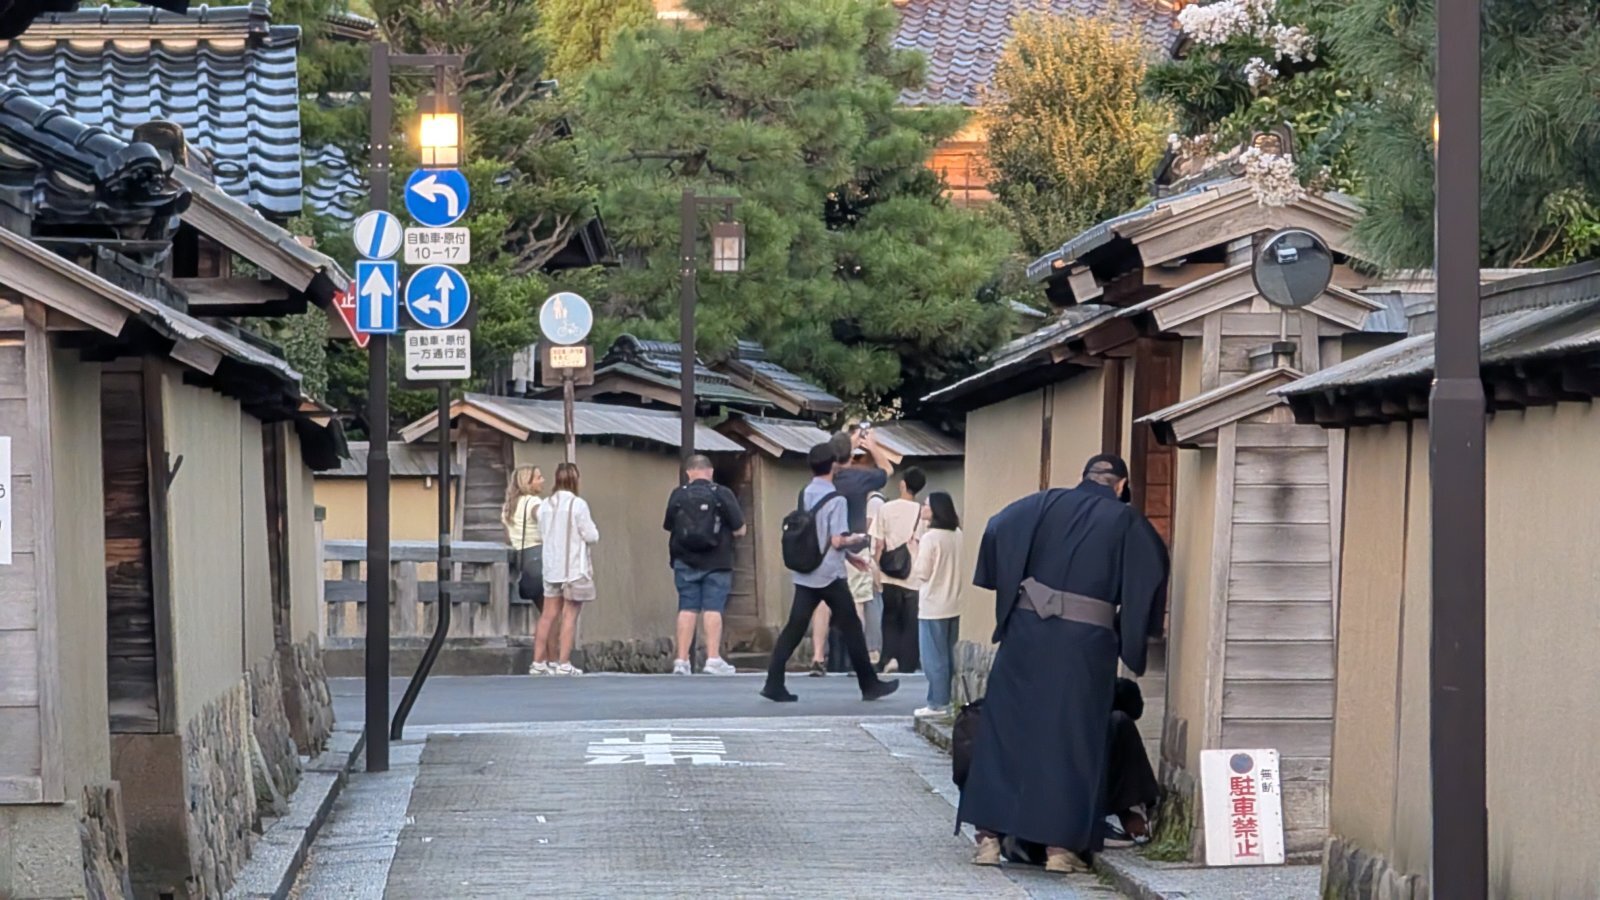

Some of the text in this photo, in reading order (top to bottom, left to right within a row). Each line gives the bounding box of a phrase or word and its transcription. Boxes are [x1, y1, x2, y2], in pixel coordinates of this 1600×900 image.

[407, 232, 466, 245] 自動車・原付
[409, 335, 466, 346] 自動車・原付
[409, 348, 467, 359] 一方通行路
[1229, 775, 1259, 858] 駐車禁止
